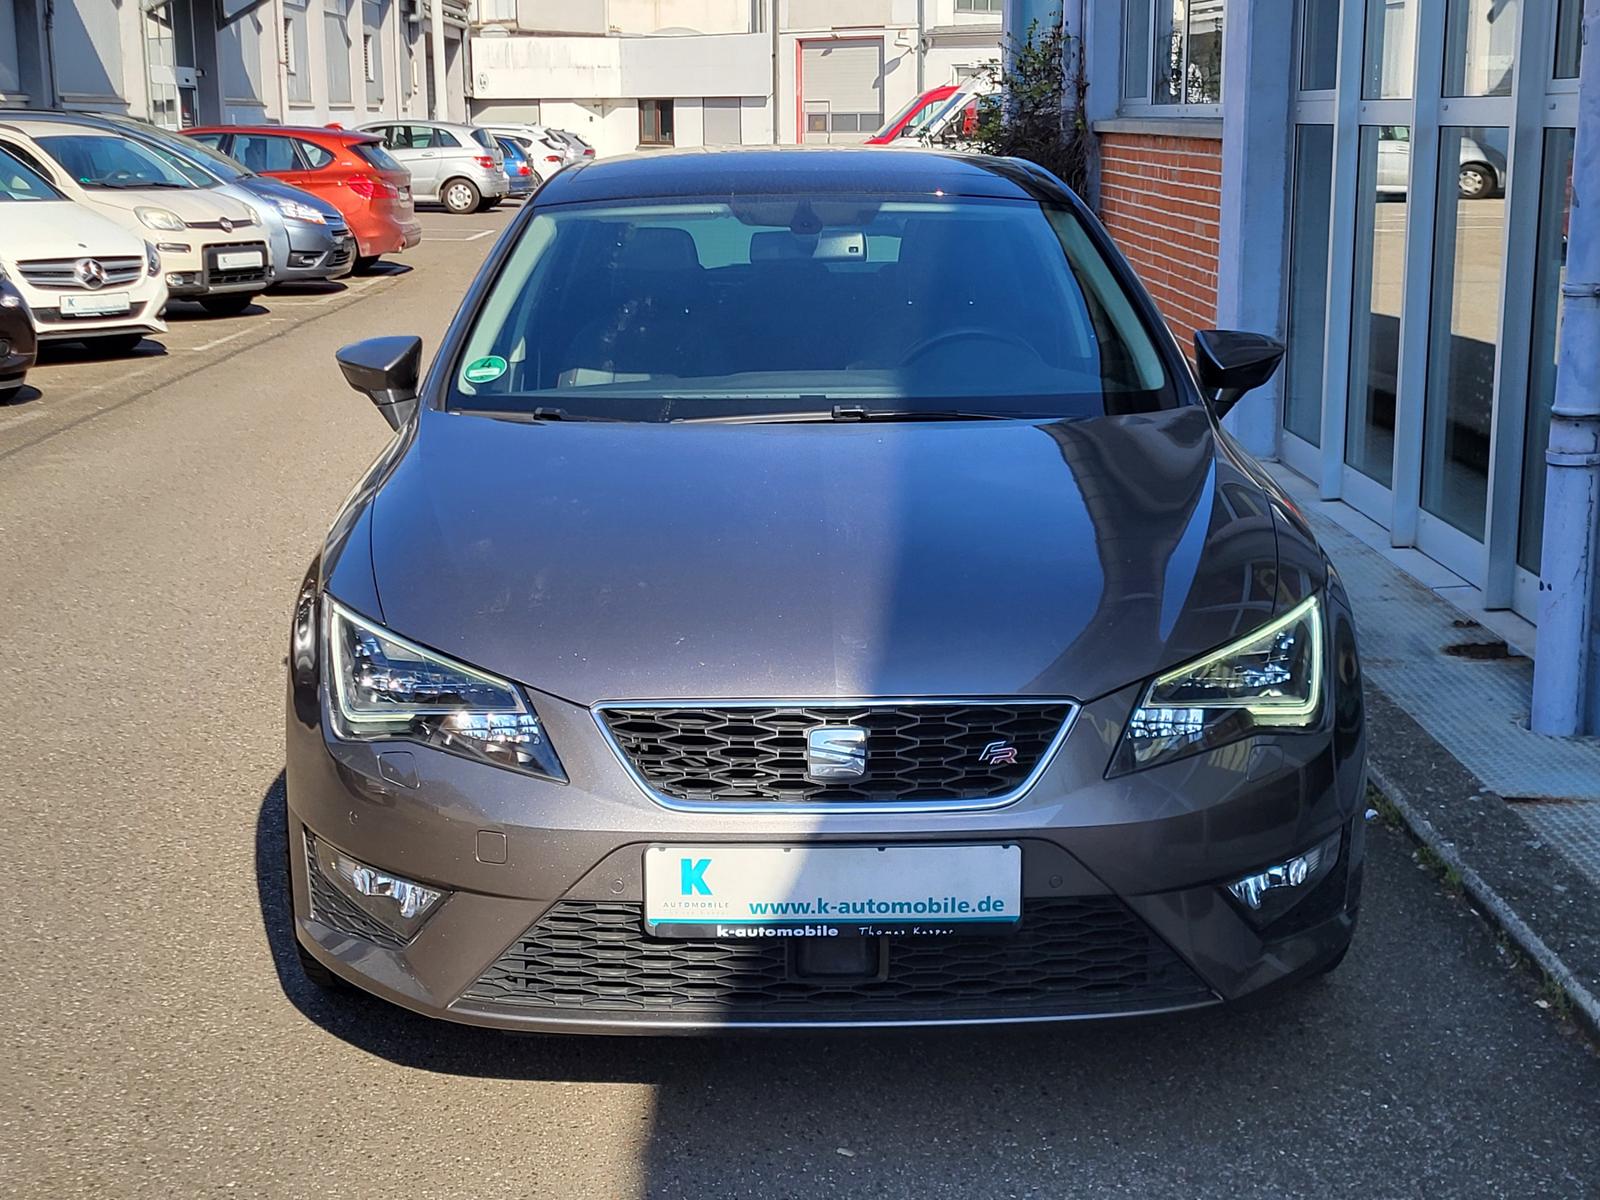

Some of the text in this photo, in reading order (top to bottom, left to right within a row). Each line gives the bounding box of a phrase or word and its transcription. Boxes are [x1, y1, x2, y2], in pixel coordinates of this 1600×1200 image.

[481, 358, 492, 369] 4
[680, 858, 713, 896] K
[663, 901, 729, 909] AUTOMOBILE
[749, 896, 1005, 915] www.k-automobile.de
[716, 925, 839, 938] k-automobile
[858, 926, 905, 937] Thomas
